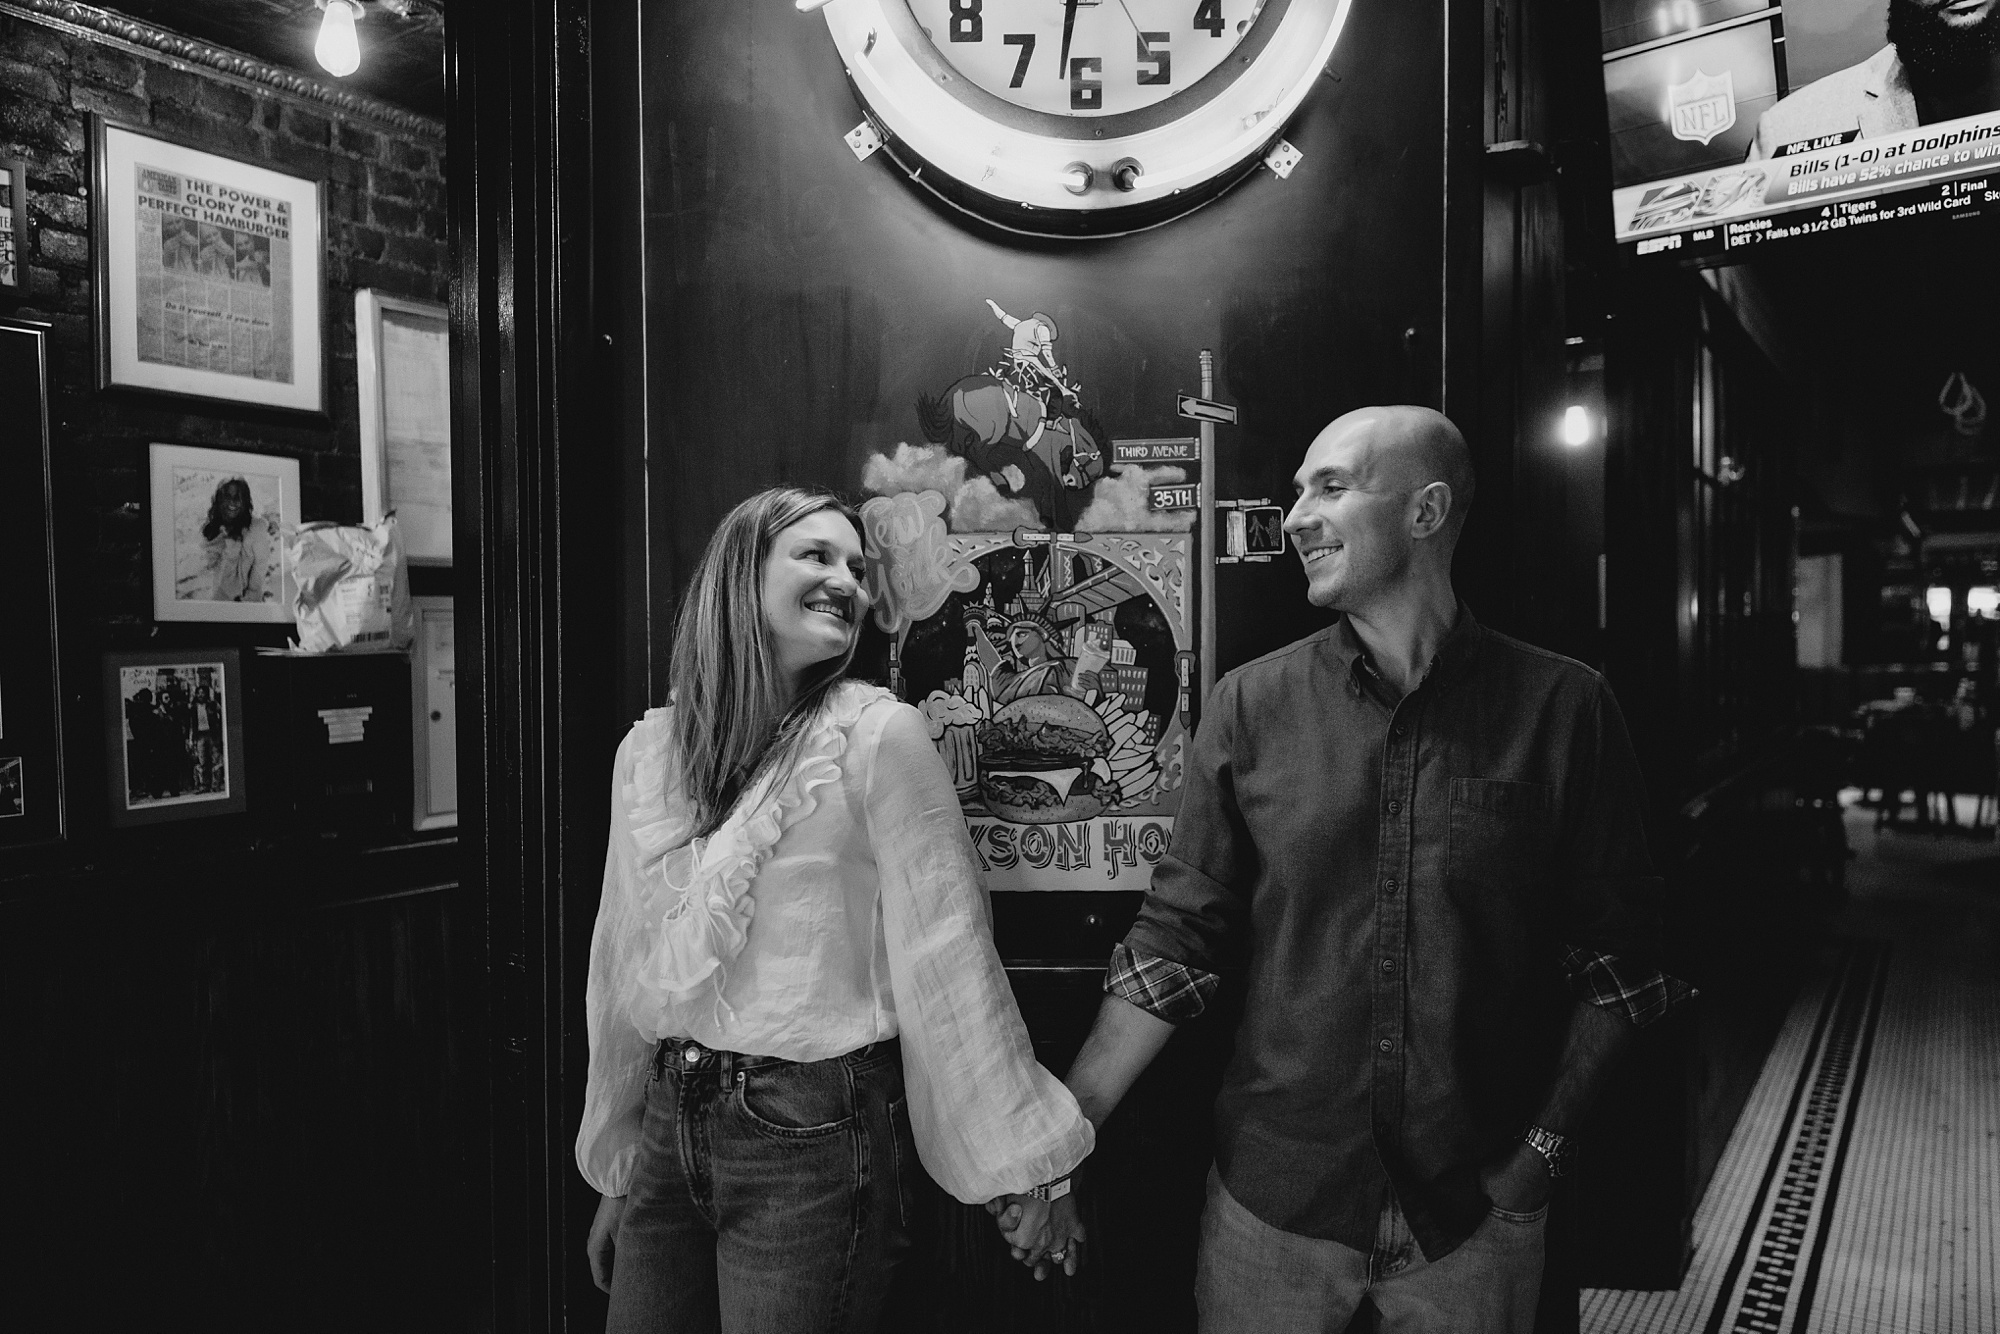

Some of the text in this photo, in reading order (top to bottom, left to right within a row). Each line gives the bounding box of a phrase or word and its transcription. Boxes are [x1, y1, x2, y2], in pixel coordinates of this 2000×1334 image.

[950, 0, 982, 42] 8
[1194, 0, 1225, 37] 4
[1004, 34, 1035, 88] 7
[1137, 32, 1170, 84] 5
[1070, 57, 1102, 109] 6
[1681, 101, 1726, 130] NFL
[1786, 134, 1842, 155] NFL LIVE
[1790, 159, 1829, 177] Bills
[1835, 148, 1879, 171] (1-0)
[1885, 143, 1906, 158] at
[1787, 142, 2000, 196] Bills have 52% chance to win
[186, 179, 286, 214] THE POWER &
[186, 193, 288, 227] GLORY OF THE
[1730, 180, 1987, 234] Rockies 4 Tigers 2 Final
[138, 195, 289, 240] PERFECT HAMBURGER
[1730, 190, 2000, 247] DET Falls to 3 1/2 GB Twins for 3rd Wild Card Sk
[1952, 210, 1981, 220] SAMSUNG
[1637, 234, 1682, 255] ESPN
[1118, 445, 1188, 458] THIRD AVENUE
[1154, 490, 1192, 508] 35TH
